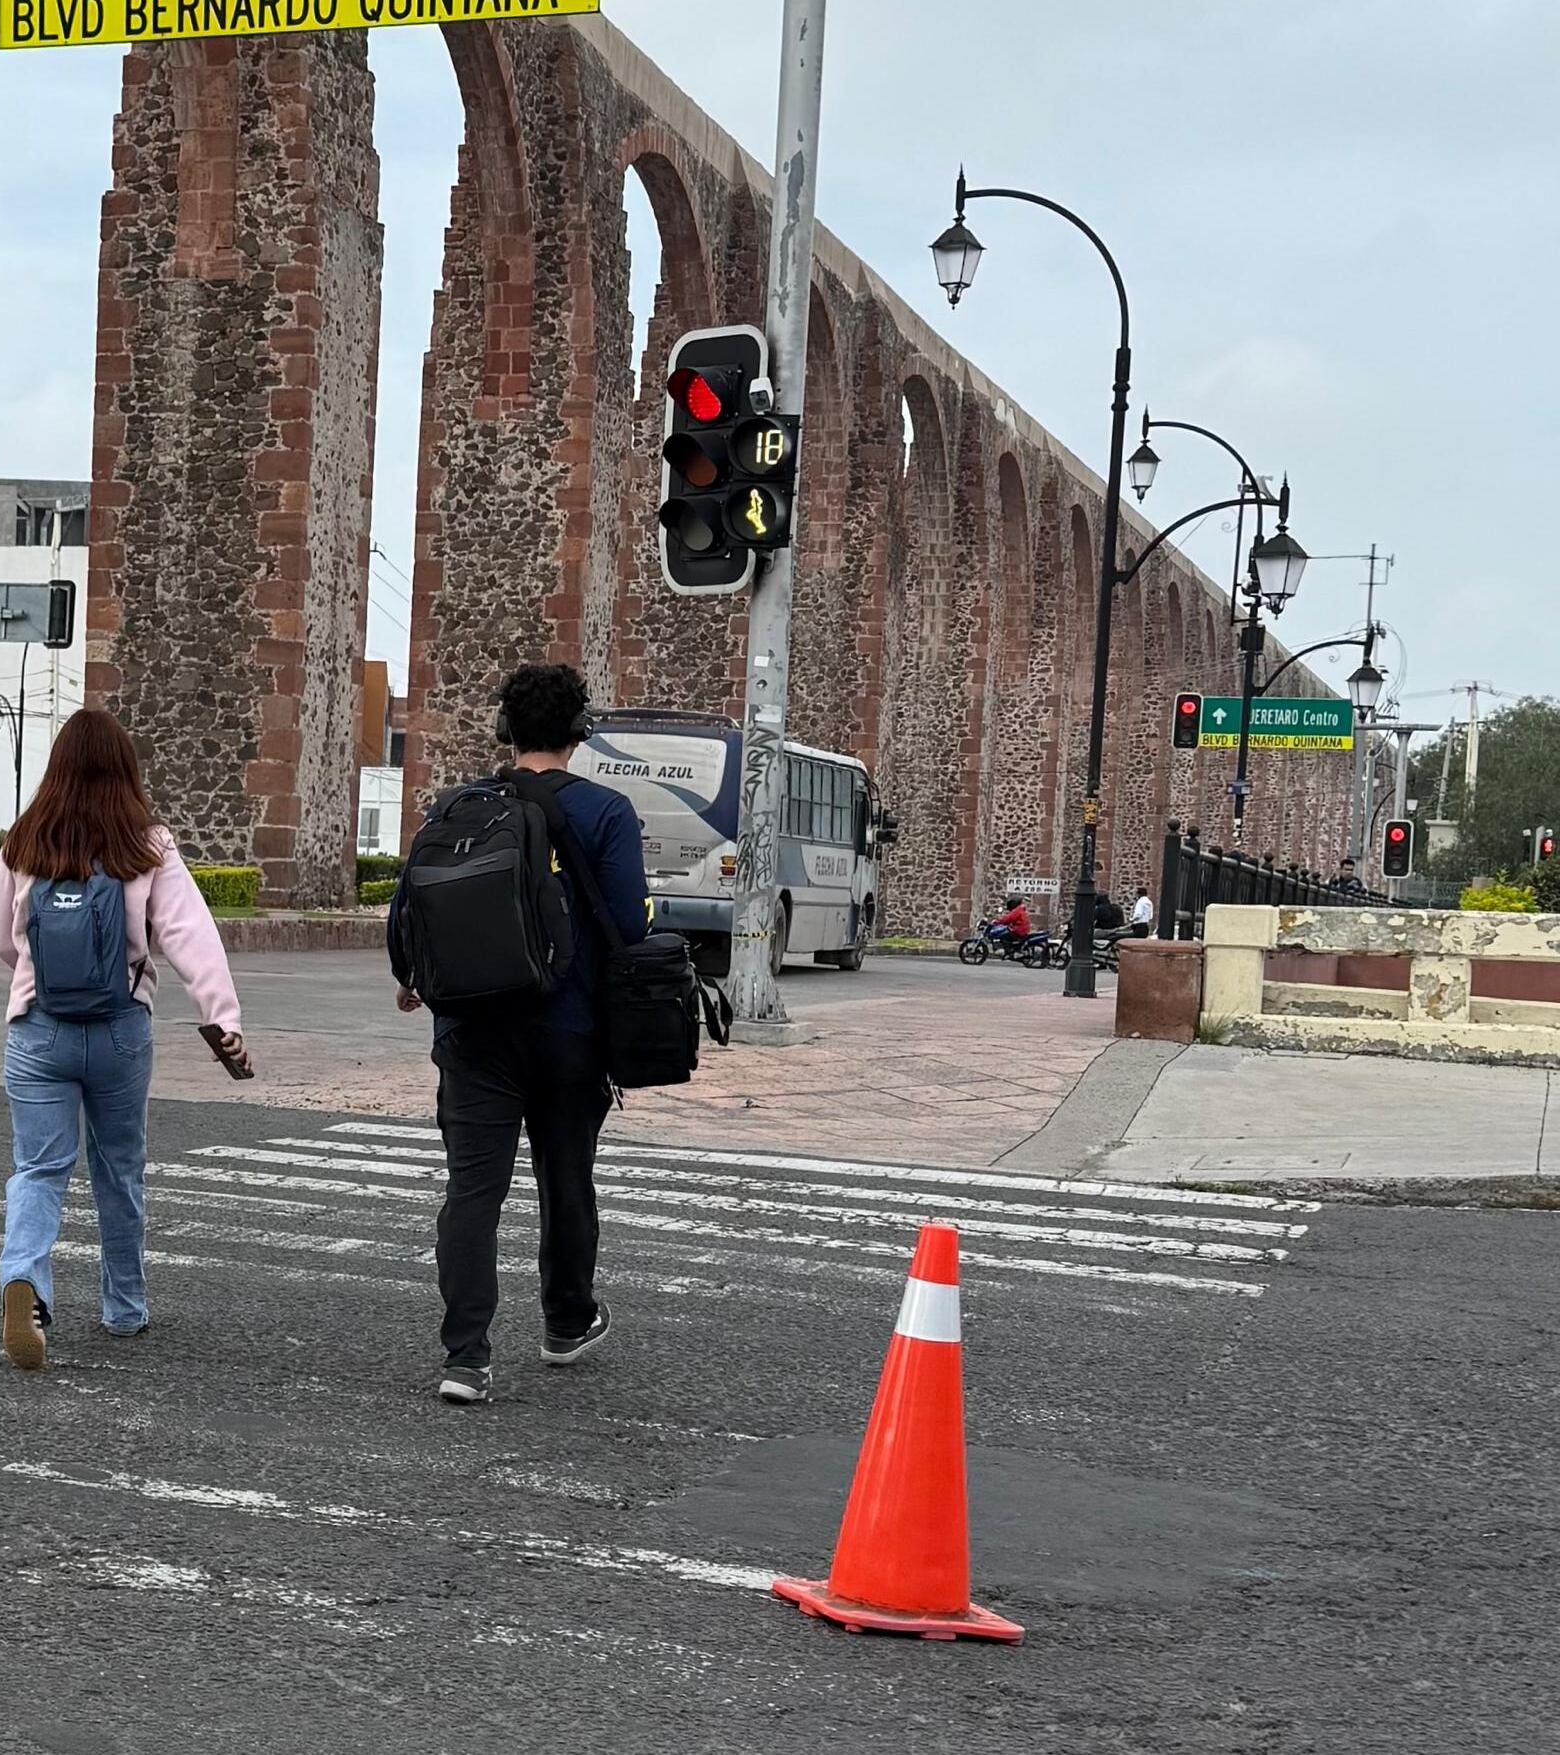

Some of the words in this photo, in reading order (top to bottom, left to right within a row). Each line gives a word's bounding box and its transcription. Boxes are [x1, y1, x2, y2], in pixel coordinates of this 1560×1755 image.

[13, 0, 104, 41] BLVD
[125, 0, 338, 36] BERNARDO
[755, 429, 784, 466] 18
[1249, 709, 1299, 725] UERETARO
[1303, 709, 1339, 726] Centro
[1202, 734, 1229, 746] BLVD
[1232, 735, 1288, 747] BRNARDO
[1293, 736, 1343, 748] QUINTANA
[597, 763, 650, 777] FLECHA
[658, 766, 694, 779] AZUL
